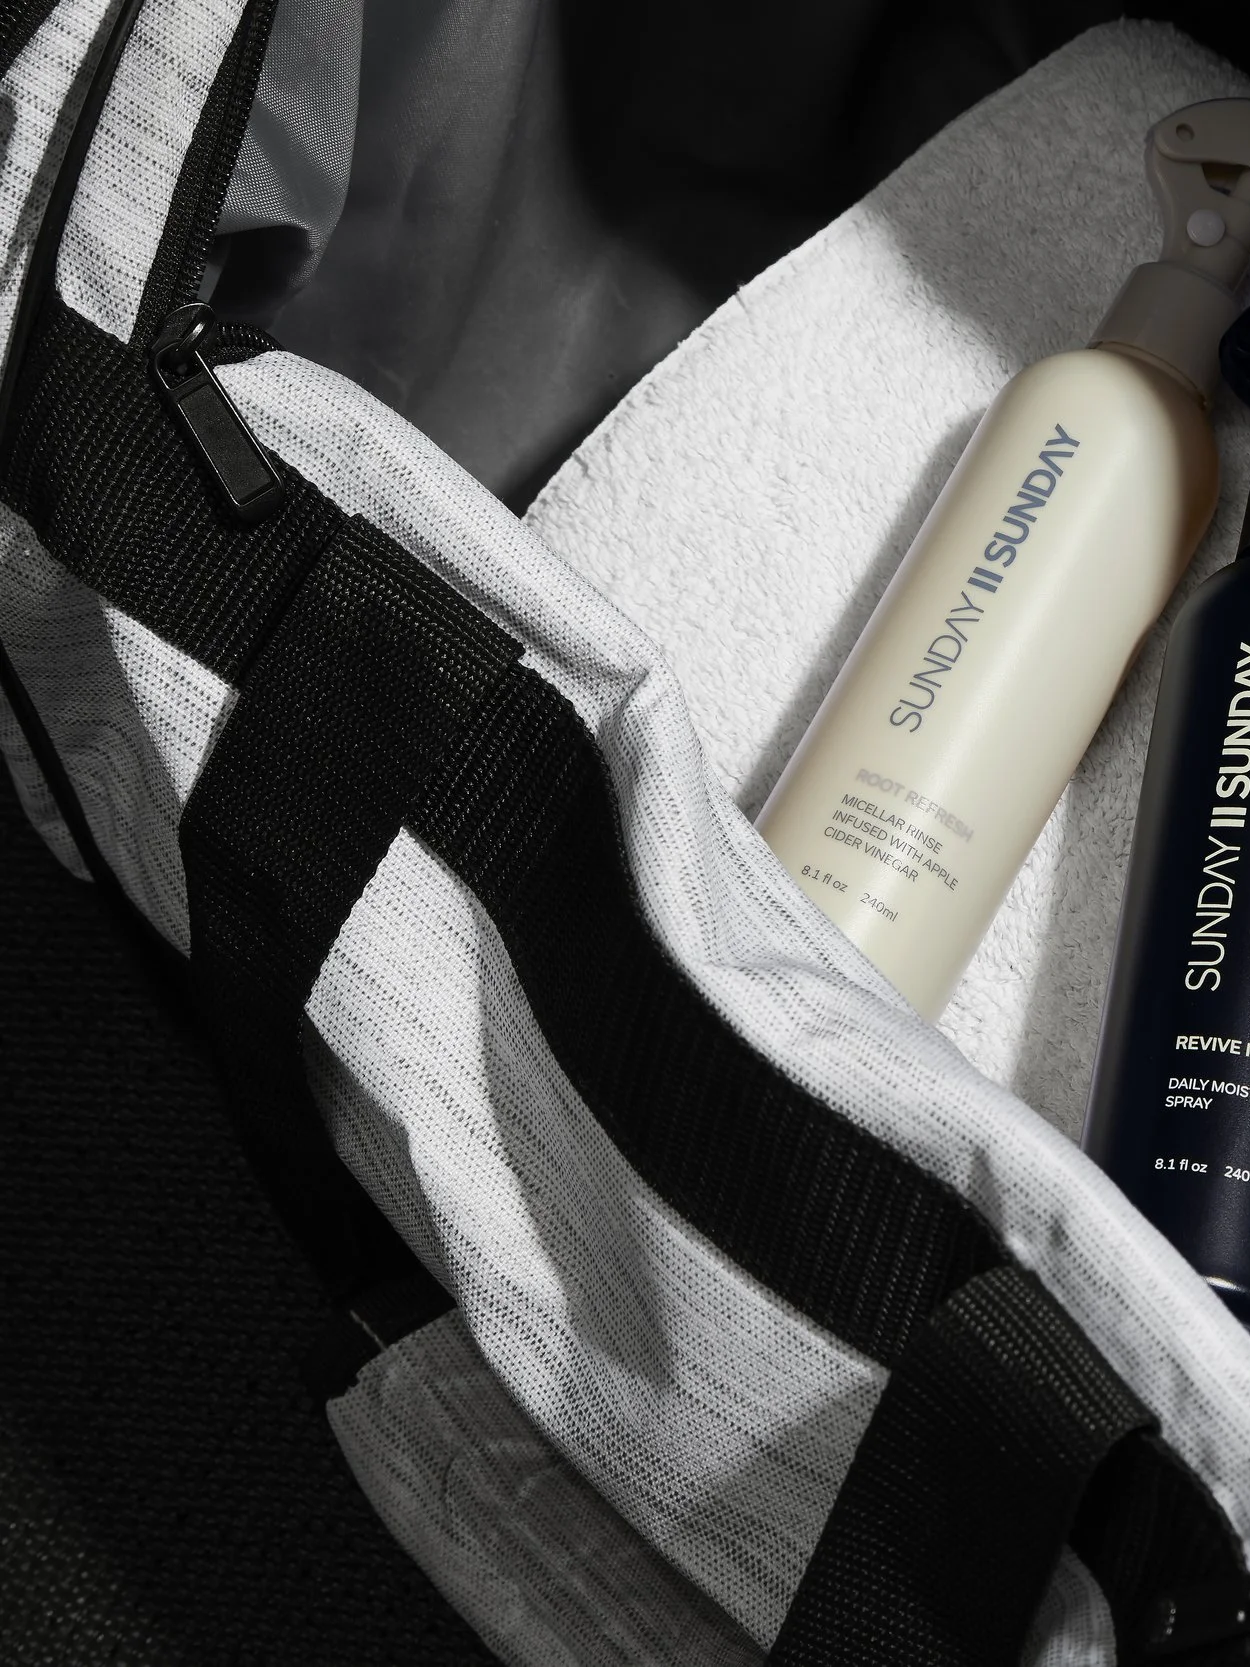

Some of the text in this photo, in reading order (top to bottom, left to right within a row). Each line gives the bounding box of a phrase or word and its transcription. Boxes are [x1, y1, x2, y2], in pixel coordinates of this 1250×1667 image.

[889, 590, 984, 733] SUNDAY
[984, 423, 1080, 568] SUNDAY
[841, 793, 943, 854] MICELLAR RINSE
[855, 768, 975, 843] ROOT REFRESH
[823, 826, 919, 882] CIDER VINEGAR
[832, 809, 959, 891] INFUSED WITH APPLE
[801, 864, 899, 922] 8.1 fl oz 240ml
[1184, 835, 1241, 992] SUNDAY
[1175, 1035, 1242, 1055] REVIVE
[1164, 1095, 1213, 1110] SPRAY
[1168, 1077, 1210, 1091] DAILY
[1154, 1158, 1176, 1171] 8.1
[1179, 1158, 1189, 1171] fl
[1191, 1162, 1208, 1173] oz
